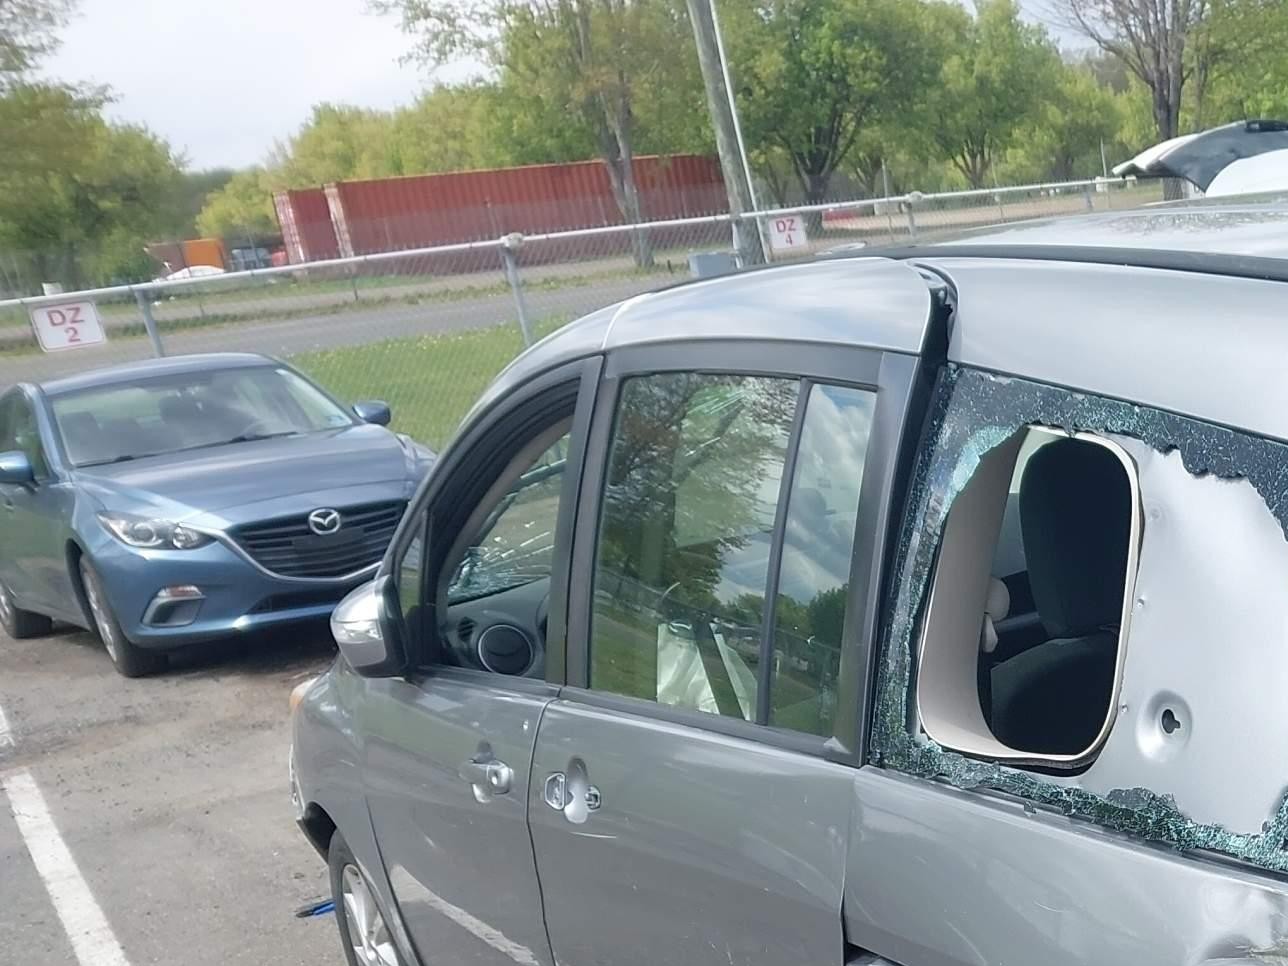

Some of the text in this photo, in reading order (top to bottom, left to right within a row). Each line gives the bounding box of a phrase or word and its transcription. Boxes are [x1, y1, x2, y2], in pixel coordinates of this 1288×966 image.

[775, 219, 796, 233] DZ
[47, 307, 84, 327] DZ
[64, 327, 81, 343] 2
